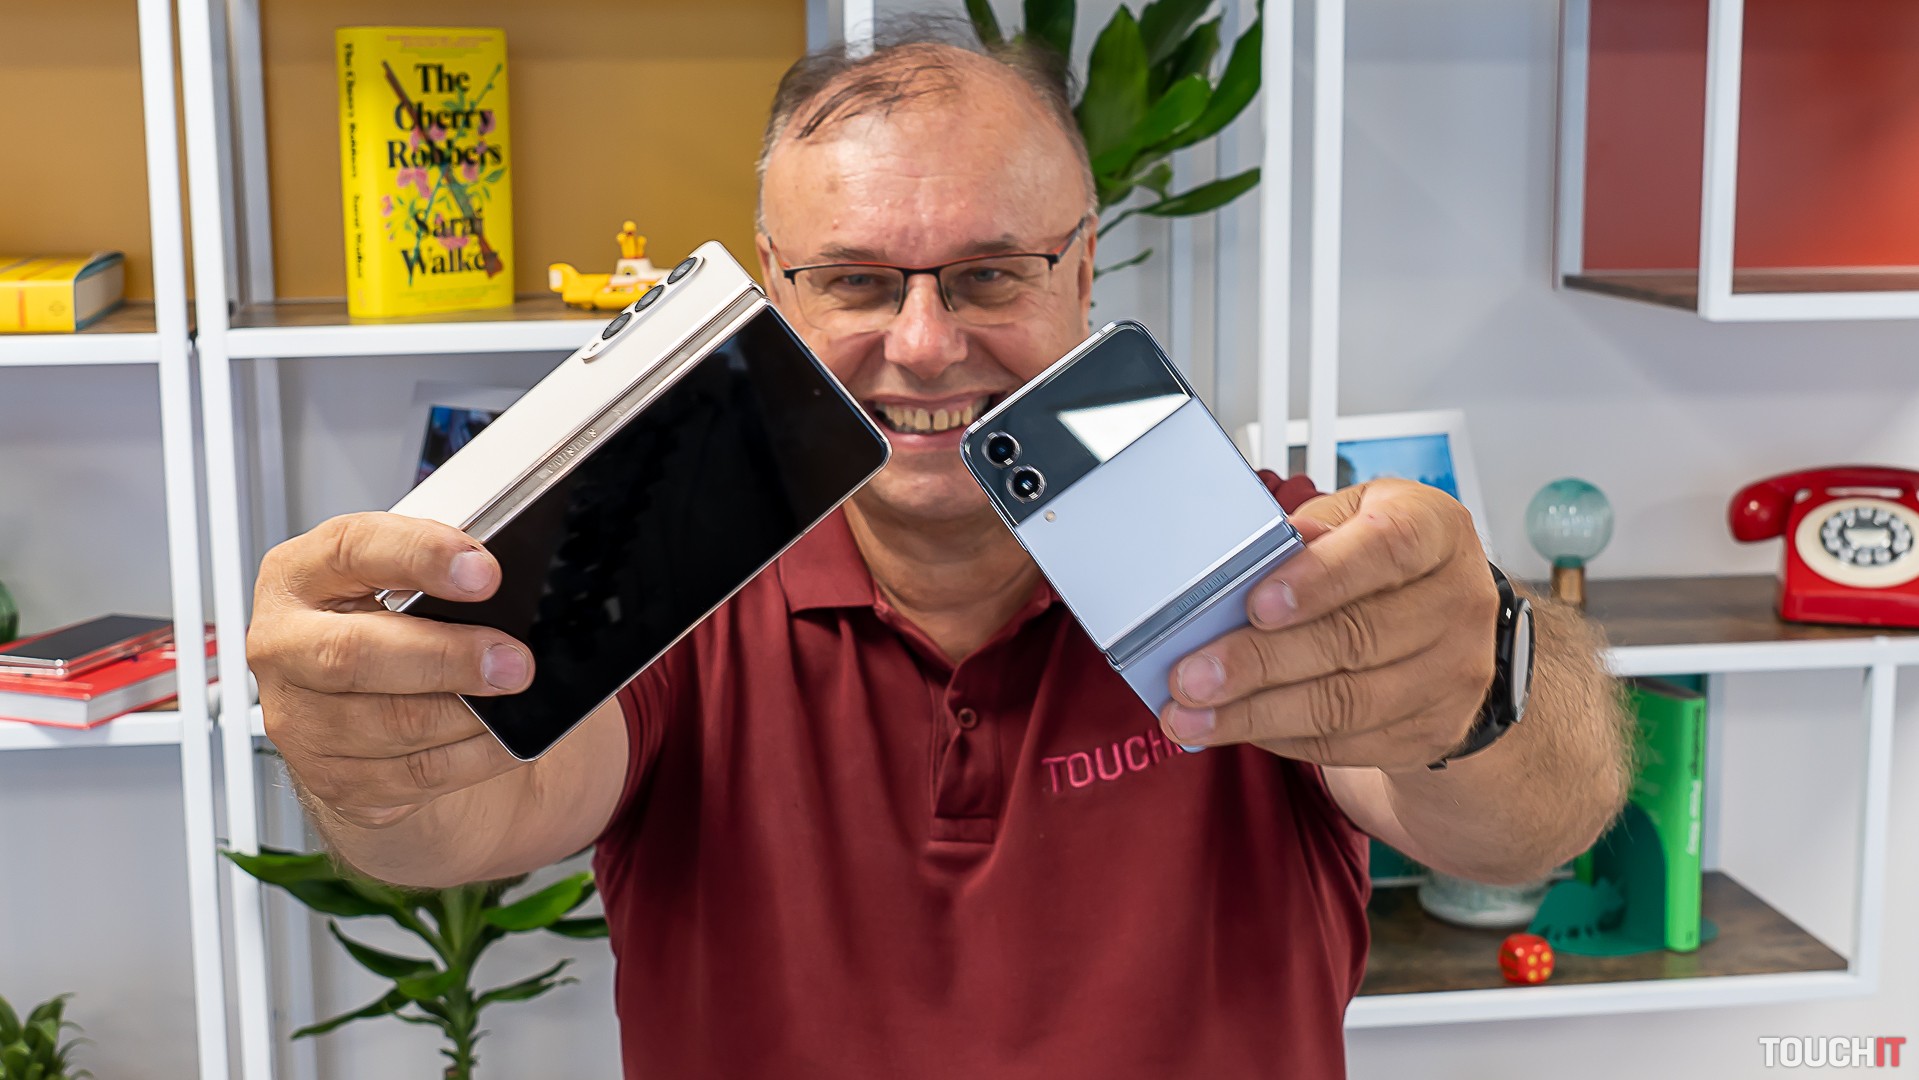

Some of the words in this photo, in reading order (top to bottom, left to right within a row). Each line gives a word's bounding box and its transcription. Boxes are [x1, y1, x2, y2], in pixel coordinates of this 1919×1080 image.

[414, 63, 470, 93] The
[394, 100, 494, 136] Cherry
[387, 138, 502, 170] Robbers
[1041, 729, 1184, 793] TOUCH
